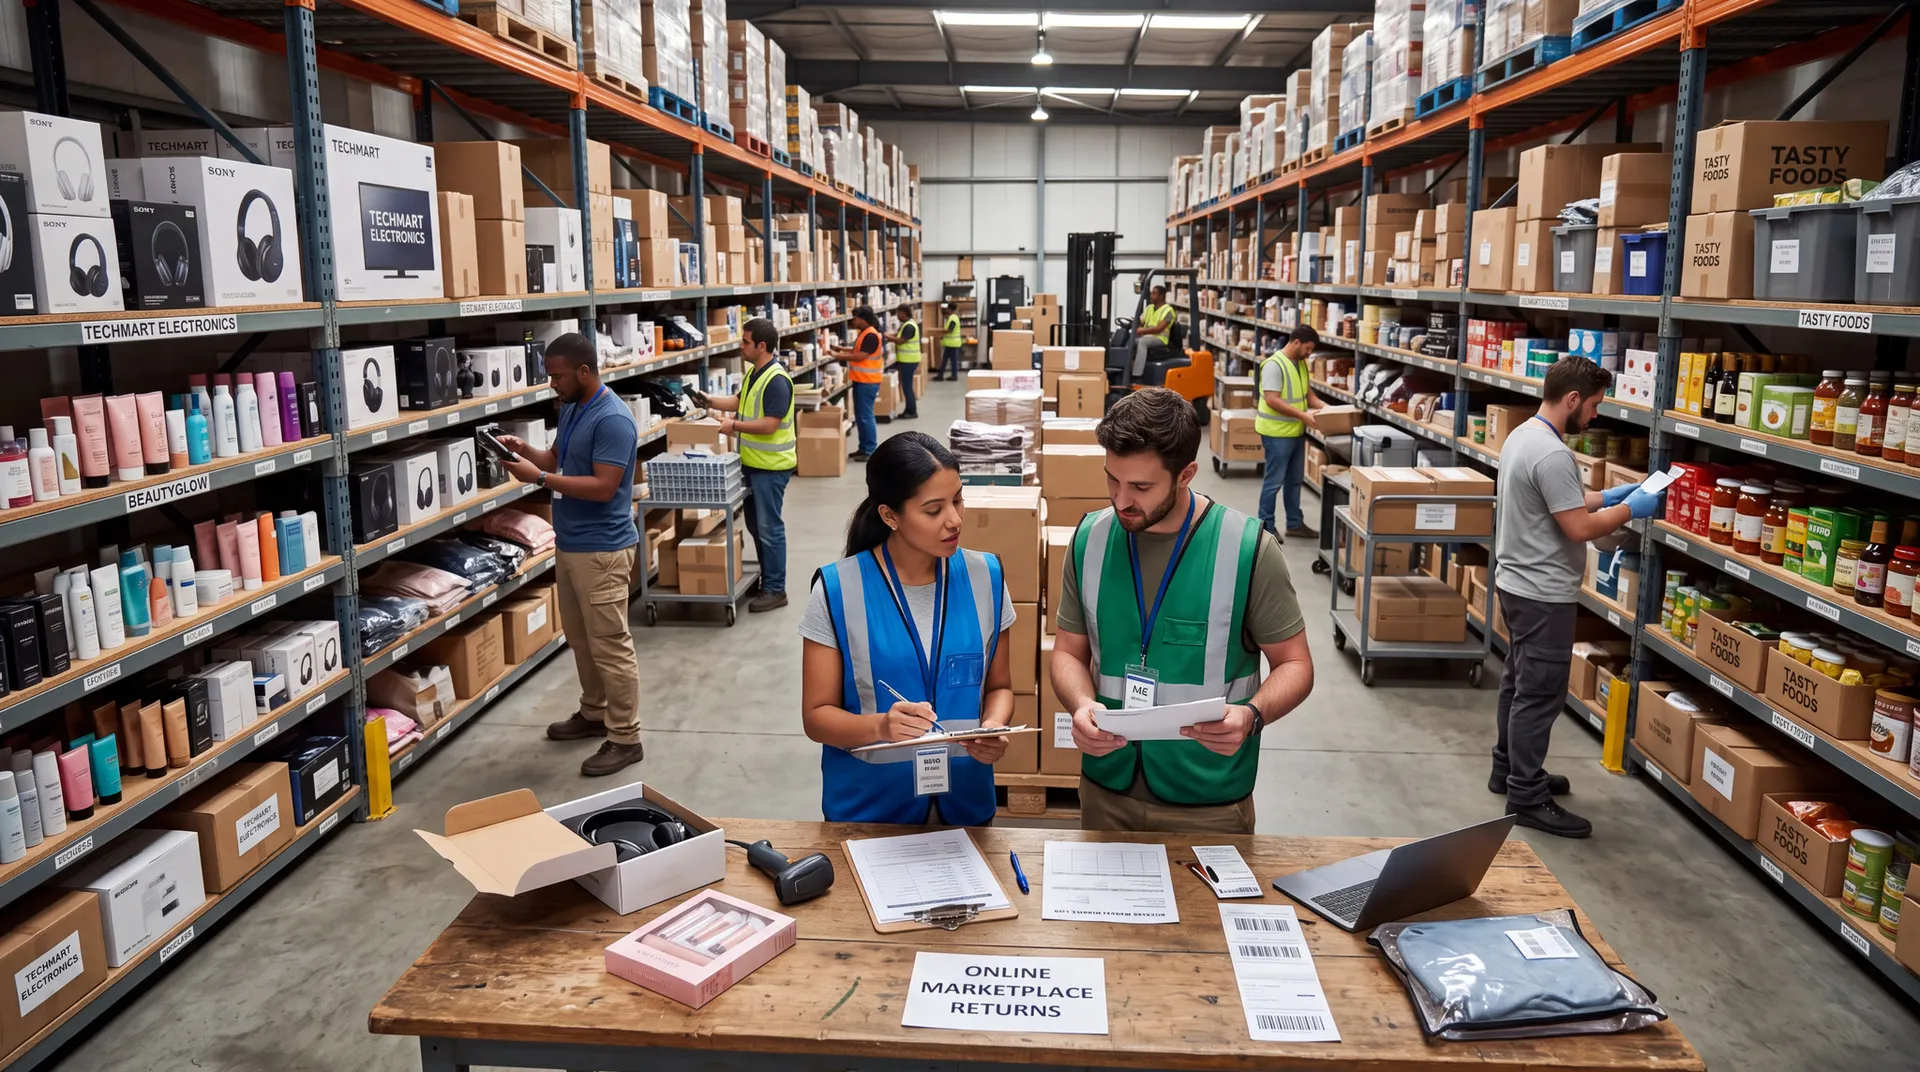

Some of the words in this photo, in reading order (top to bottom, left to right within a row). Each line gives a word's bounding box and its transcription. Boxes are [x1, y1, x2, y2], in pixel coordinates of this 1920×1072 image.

[29, 118, 53, 128] SONY
[147, 141, 209, 151] TECHMART
[332, 139, 380, 159] TECHMART
[1704, 154, 1730, 169] TASTY
[1771, 146, 1850, 165] TASTY
[208, 166, 236, 178] SONY
[1703, 168, 1729, 182] FOODS
[1769, 168, 1847, 186] FOODS
[133, 206, 155, 214] SONY
[369, 210, 424, 230] TECHMART
[371, 231, 425, 245] ELECTRONICS
[1695, 242, 1721, 254] TASTY
[1693, 256, 1720, 267] FOODS
[84, 321, 157, 340] TECHMART
[159, 317, 236, 335] ELECTRONICS
[1801, 312, 1831, 327] TASTY
[1833, 315, 1870, 329] FOODS
[128, 476, 208, 509] BEAUTYGLOW
[1712, 628, 1741, 652] TASTY
[1710, 644, 1740, 668] FOODS
[1784, 667, 1819, 693] TASTY
[1132, 685, 1148, 697] ME
[1782, 684, 1818, 713] FOODS
[239, 811, 277, 844] ELECTRONICS
[1776, 816, 1809, 848] TASTY
[1773, 832, 1808, 866] FOODS
[25, 945, 71, 983] TECHMART
[965, 966, 1051, 980] ONLINE
[21, 954, 79, 1001] ELECTRONICS
[921, 982, 1093, 999] MARKETPLACE
[950, 1002, 1061, 1018] RETURNS
